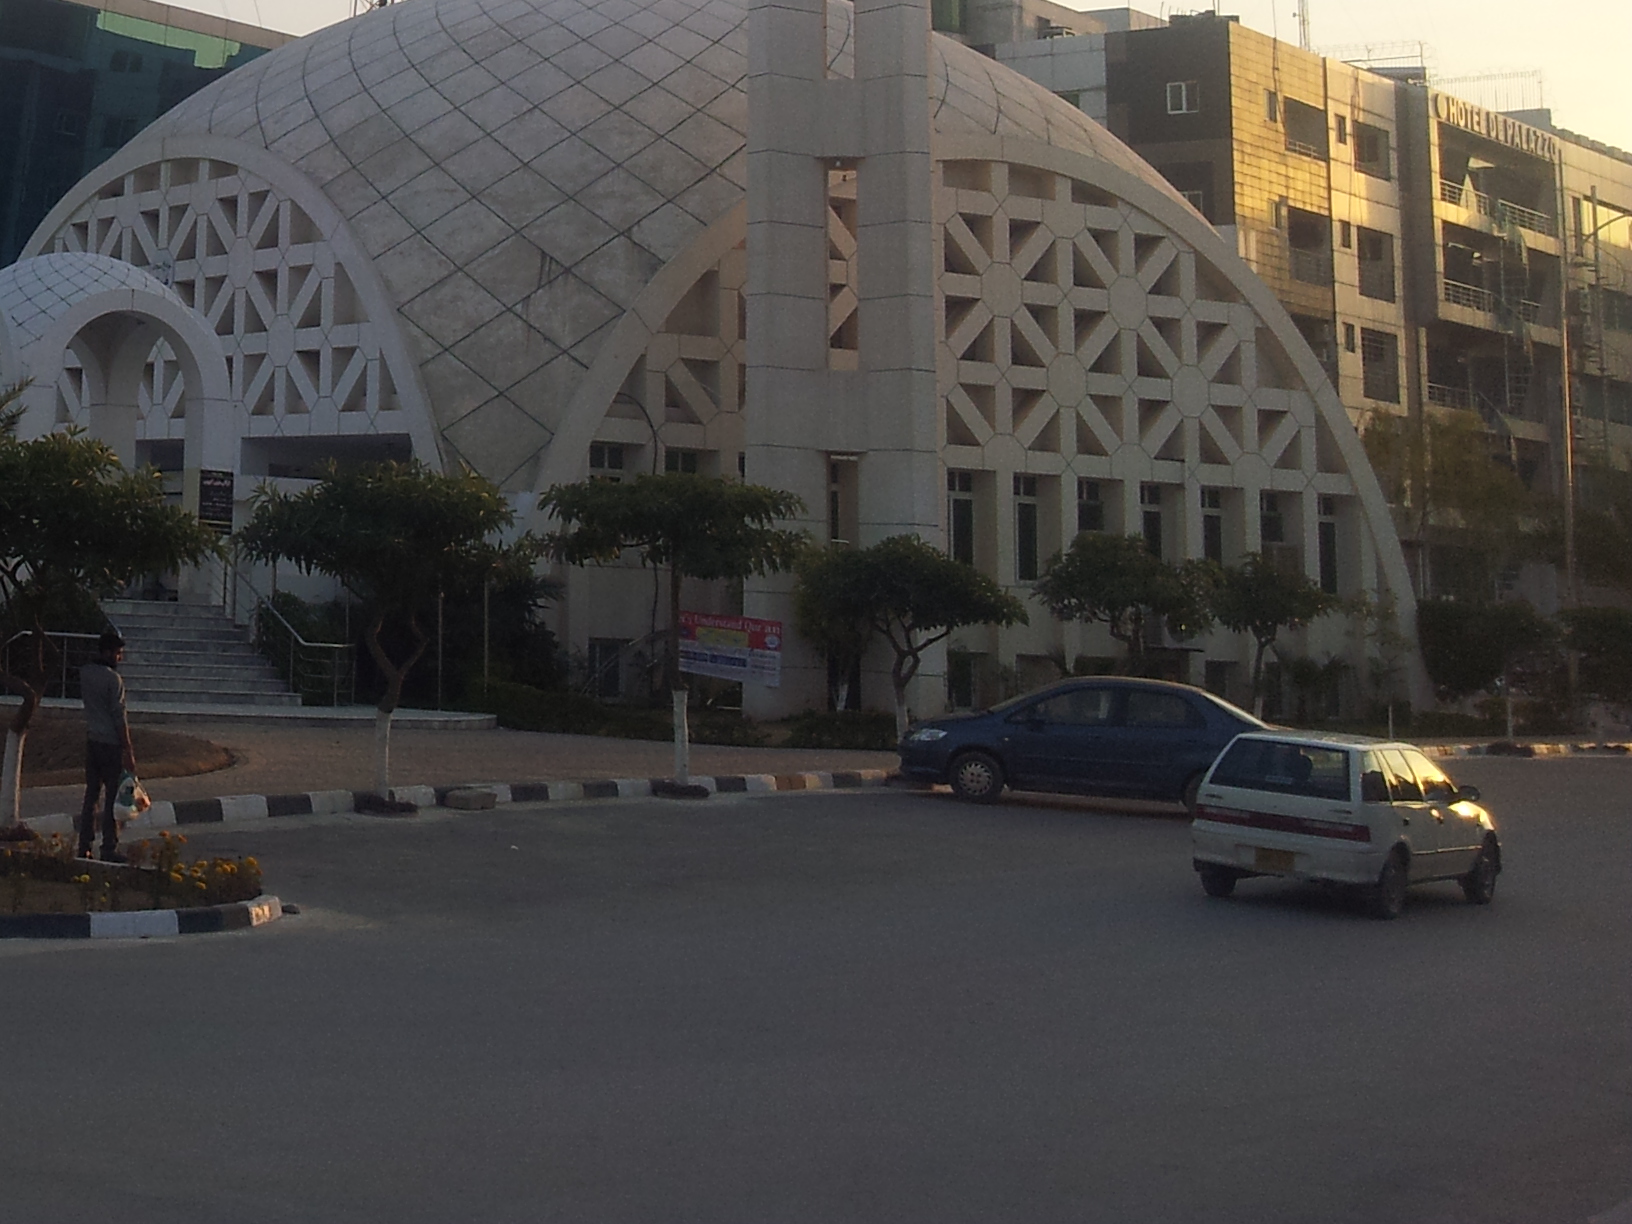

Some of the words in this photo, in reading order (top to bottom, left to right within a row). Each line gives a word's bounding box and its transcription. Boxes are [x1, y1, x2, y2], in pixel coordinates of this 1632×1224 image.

[1447, 95, 1486, 135] HOTEL
[1504, 118, 1557, 164] PALAZZO
[694, 614, 742, 630] Understand
